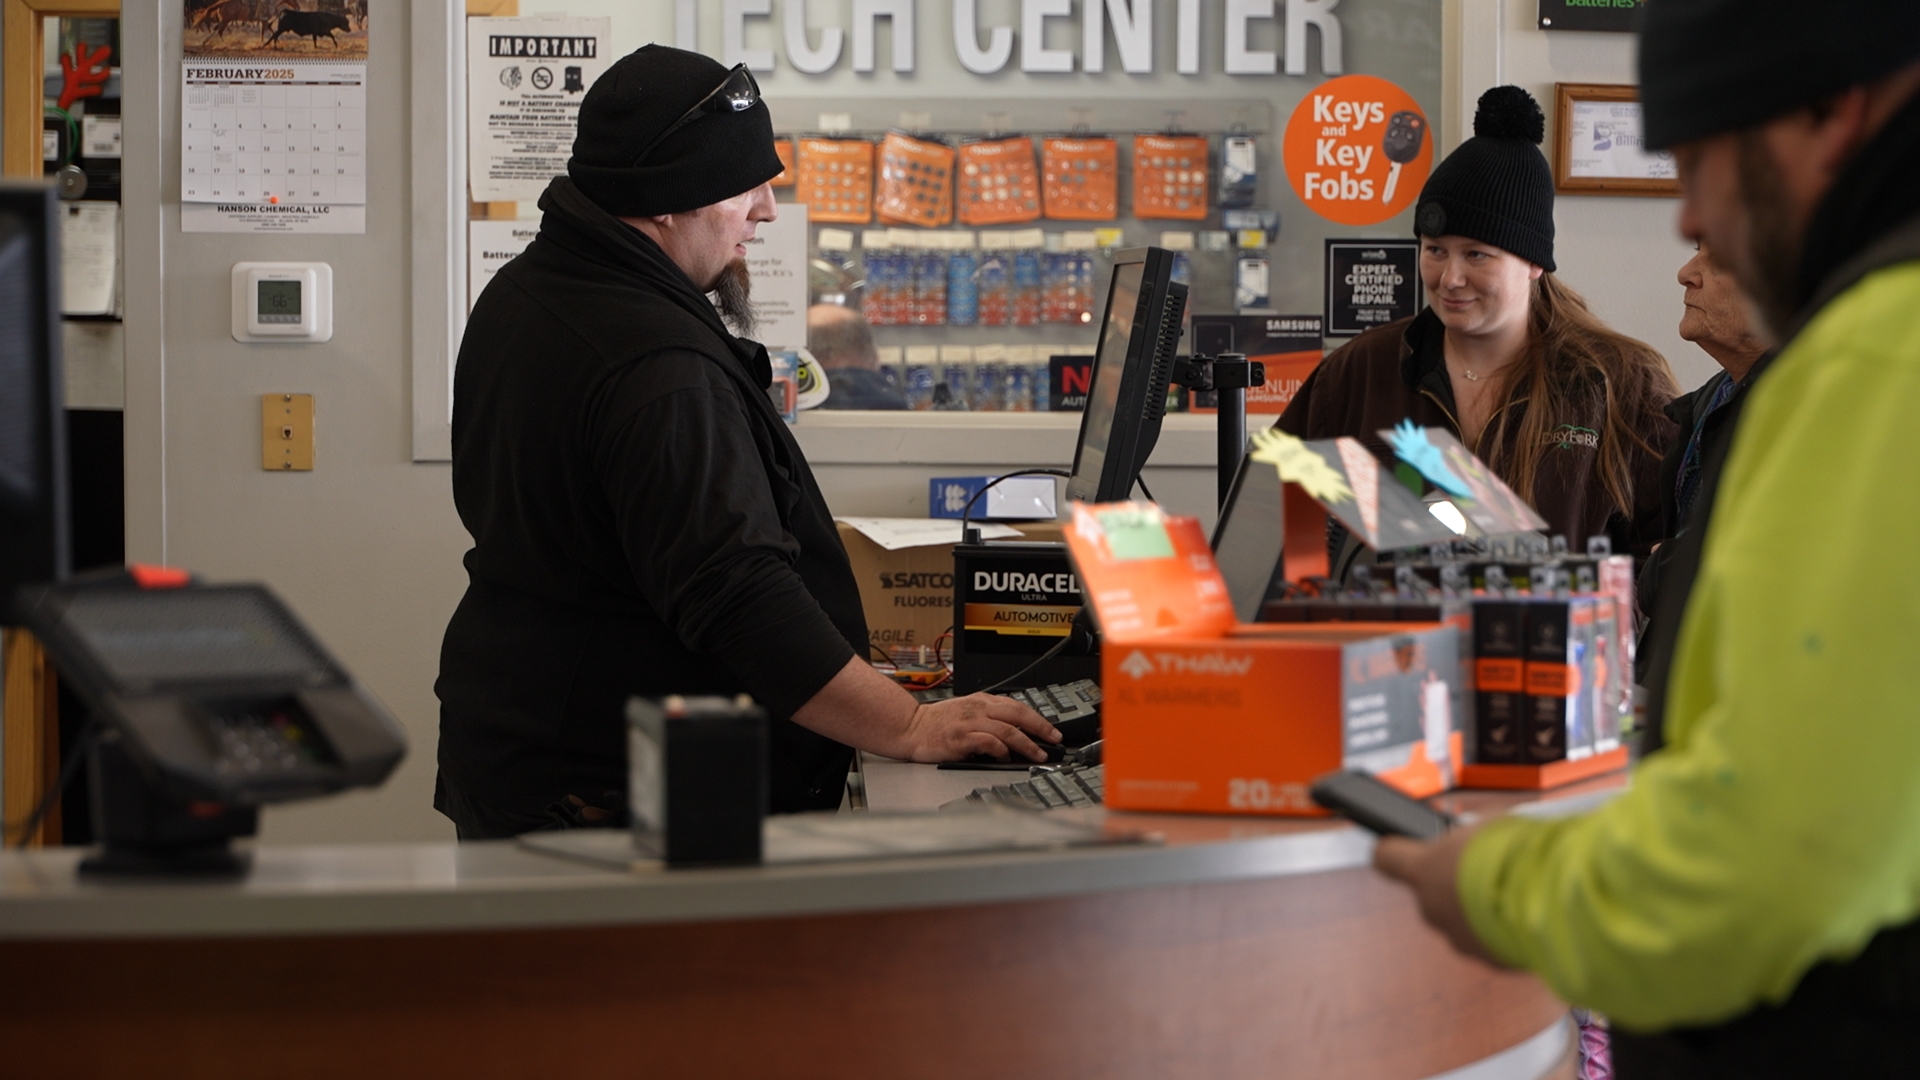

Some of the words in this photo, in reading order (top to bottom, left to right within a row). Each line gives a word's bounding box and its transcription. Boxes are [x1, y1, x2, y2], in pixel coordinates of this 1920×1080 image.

[491, 37, 596, 56] IMPORTANT
[1313, 95, 1385, 131] Keys
[1321, 123, 1347, 137] and
[1315, 138, 1374, 175] Key
[1304, 170, 1375, 201] Fobs
[259, 206, 310, 215] CHEMICAL,
[312, 206, 330, 214] LLC
[1344, 274, 1404, 285] CERTIFIED
[1354, 284, 1394, 294] PHONE
[1352, 294, 1396, 304] REPAIR.
[1266, 320, 1322, 331] SAMSUNG
[894, 572, 954, 589] SATCO
[974, 571, 1085, 594] DURACEL
[894, 596, 954, 607] FLUORES
[994, 611, 1074, 623] AUTOMOTIVE
[1228, 777, 1271, 810] 20
